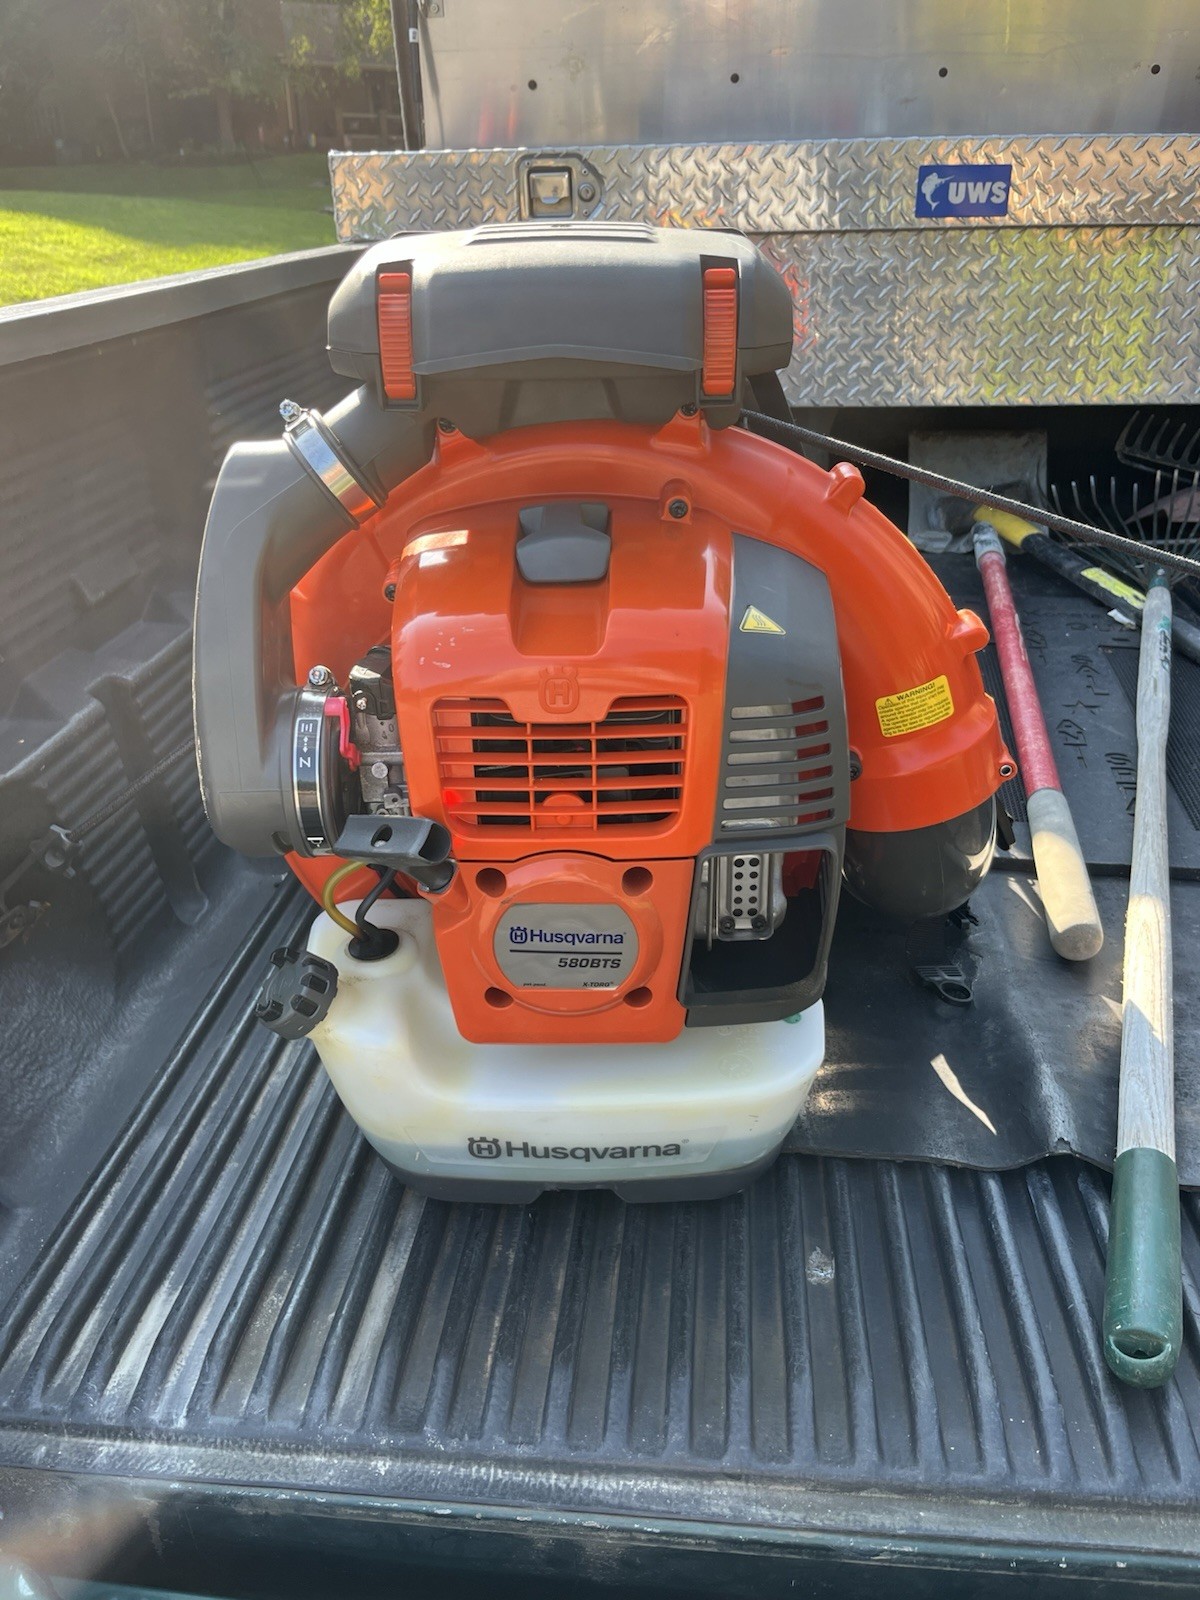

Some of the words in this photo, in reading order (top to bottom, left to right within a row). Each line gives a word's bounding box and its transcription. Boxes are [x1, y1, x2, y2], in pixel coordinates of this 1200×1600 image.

[948, 181, 1007, 204] UWS
[896, 682, 936, 701] WARNING!
[530, 929, 624, 945] Husqvarna
[558, 958, 621, 968] 580BTS
[505, 1141, 681, 1162] Husqvarna
